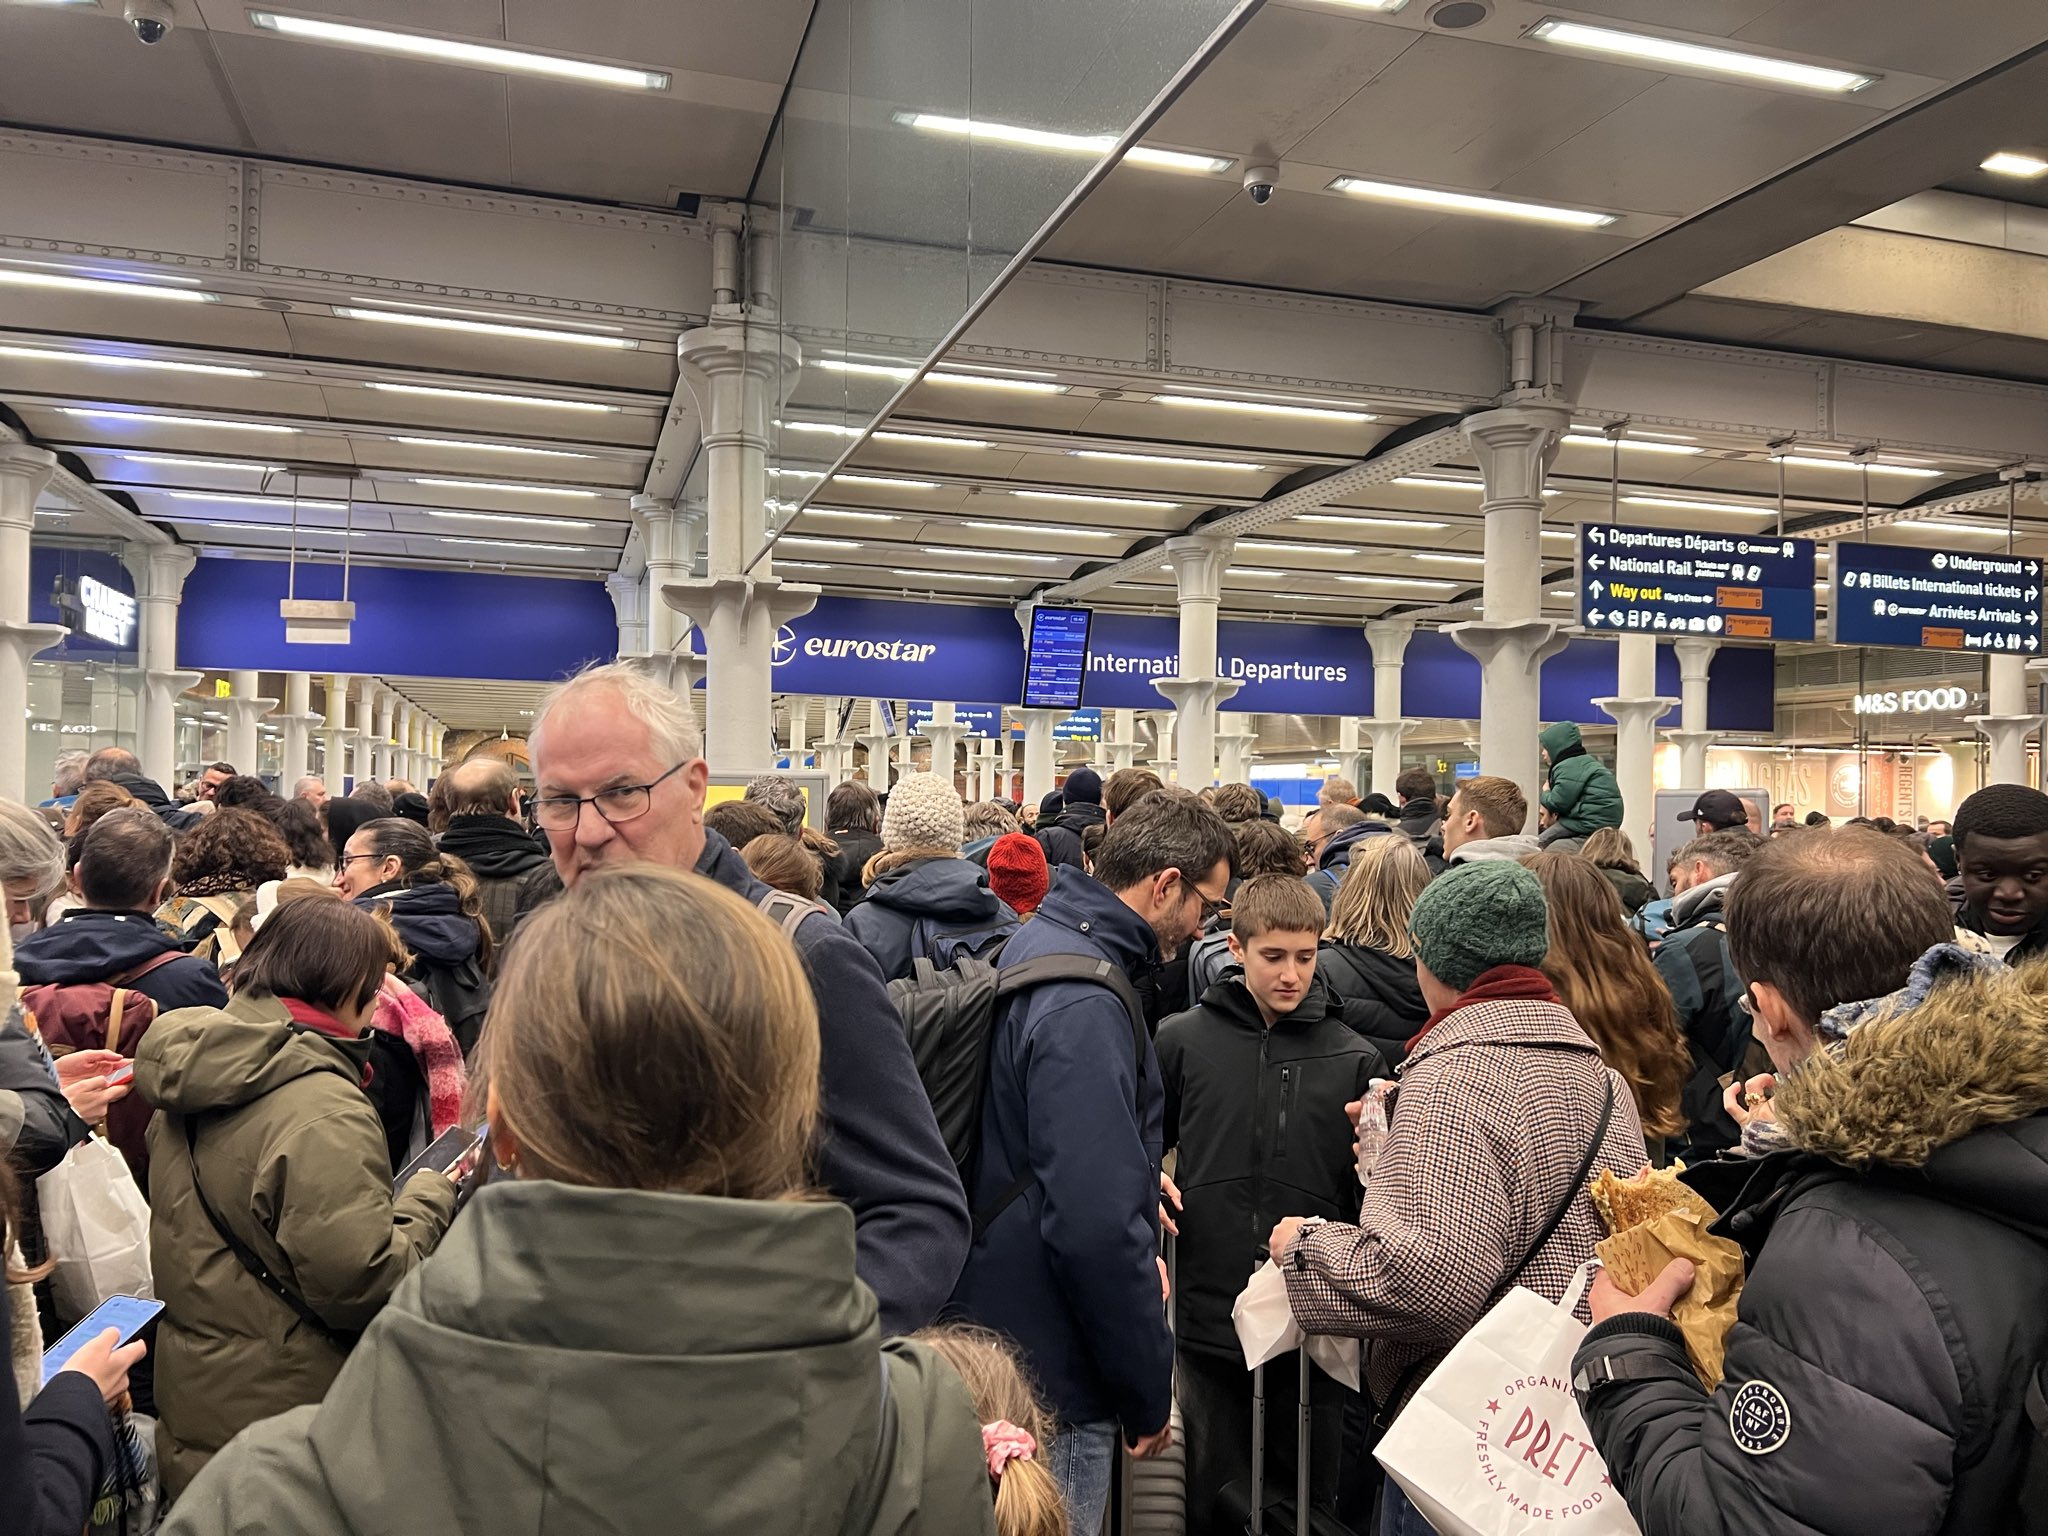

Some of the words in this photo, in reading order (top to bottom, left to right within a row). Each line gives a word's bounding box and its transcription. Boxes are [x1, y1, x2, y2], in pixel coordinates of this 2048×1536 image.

[1609, 529, 1682, 550] Departures
[1685, 534, 1734, 553] Départs
[1609, 556, 1664, 574] National
[1667, 560, 1692, 576] Rail
[1950, 555, 2022, 574] Underground
[1610, 583, 1638, 602] Way
[1640, 587, 1662, 600] out
[1873, 574, 1910, 590] Billets
[1912, 578, 1983, 596] International
[1984, 582, 2021, 598] tickets
[1755, 598, 1761, 607] B
[1929, 604, 1976, 620] Arrivées
[1978, 607, 2022, 623] Arrivals
[1764, 627, 1770, 635] A
[804, 636, 936, 662] eurostar
[1087, 651, 1224, 678] Internatil
[1231, 657, 1347, 684] Departures
[1854, 692, 1898, 715] M&S
[1902, 687, 1968, 711] FOOD
[1898, 766, 1913, 817] REGENT'S
[1504, 1375, 1577, 1399] ORGANIC
[1734, 1386, 1785, 1441] ABERCROMBIE
[1748, 1401, 1770, 1419] A&F
[1745, 1416, 1761, 1431] NY
[1504, 1405, 1595, 1487] PRET
[1736, 1429, 1762, 1450] 1892
[1476, 1420, 1507, 1492] FRESHLY
[1507, 1493, 1554, 1520] MADE
[1562, 1492, 1603, 1518] FOOD
